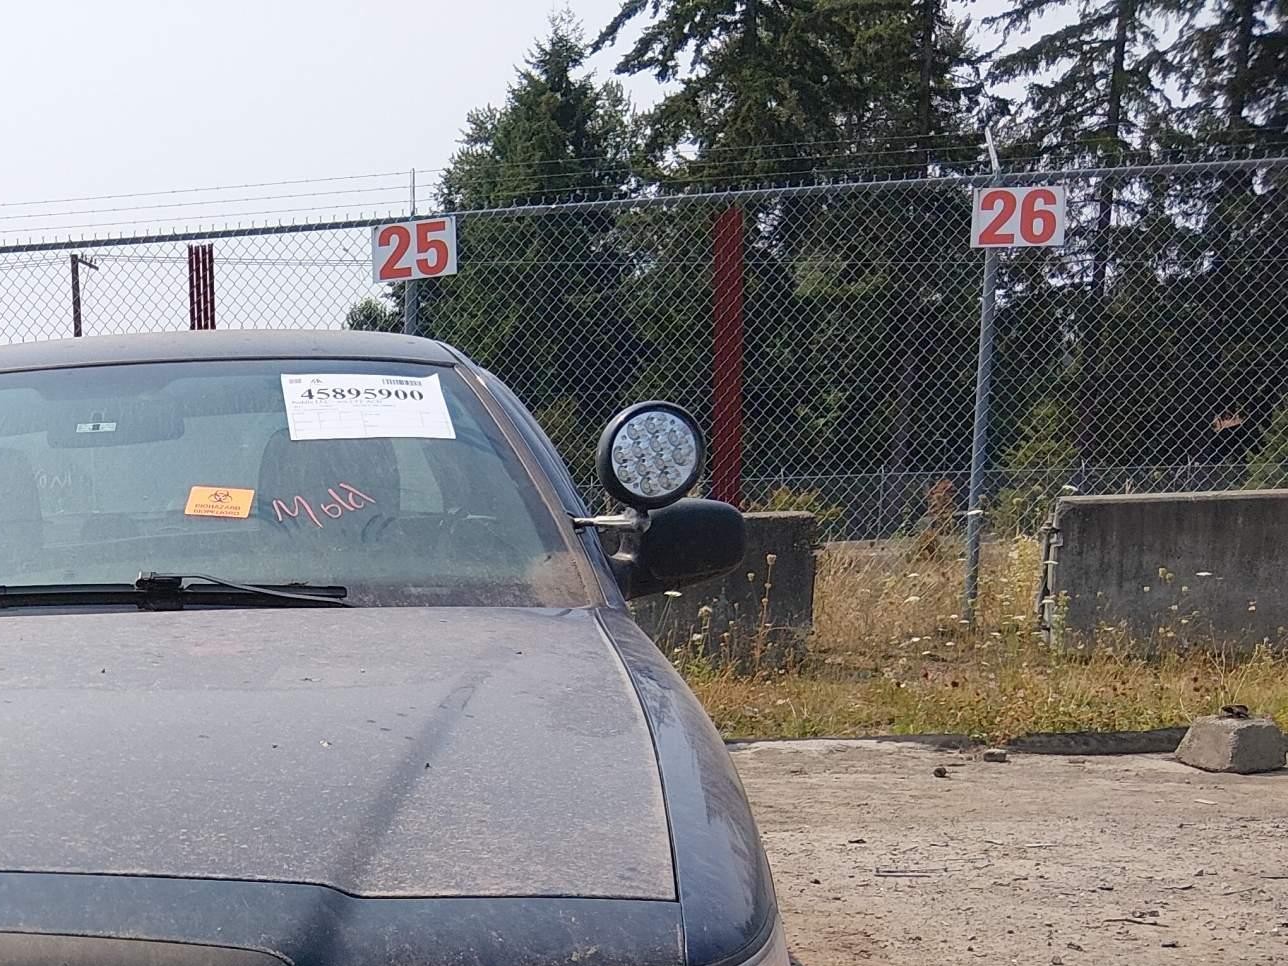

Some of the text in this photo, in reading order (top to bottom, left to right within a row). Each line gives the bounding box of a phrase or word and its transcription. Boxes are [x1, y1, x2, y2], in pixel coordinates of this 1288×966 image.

[979, 188, 1057, 245] 26
[379, 221, 449, 280] 25
[300, 388, 424, 401] 45895900
[272, 482, 377, 529] Mold
